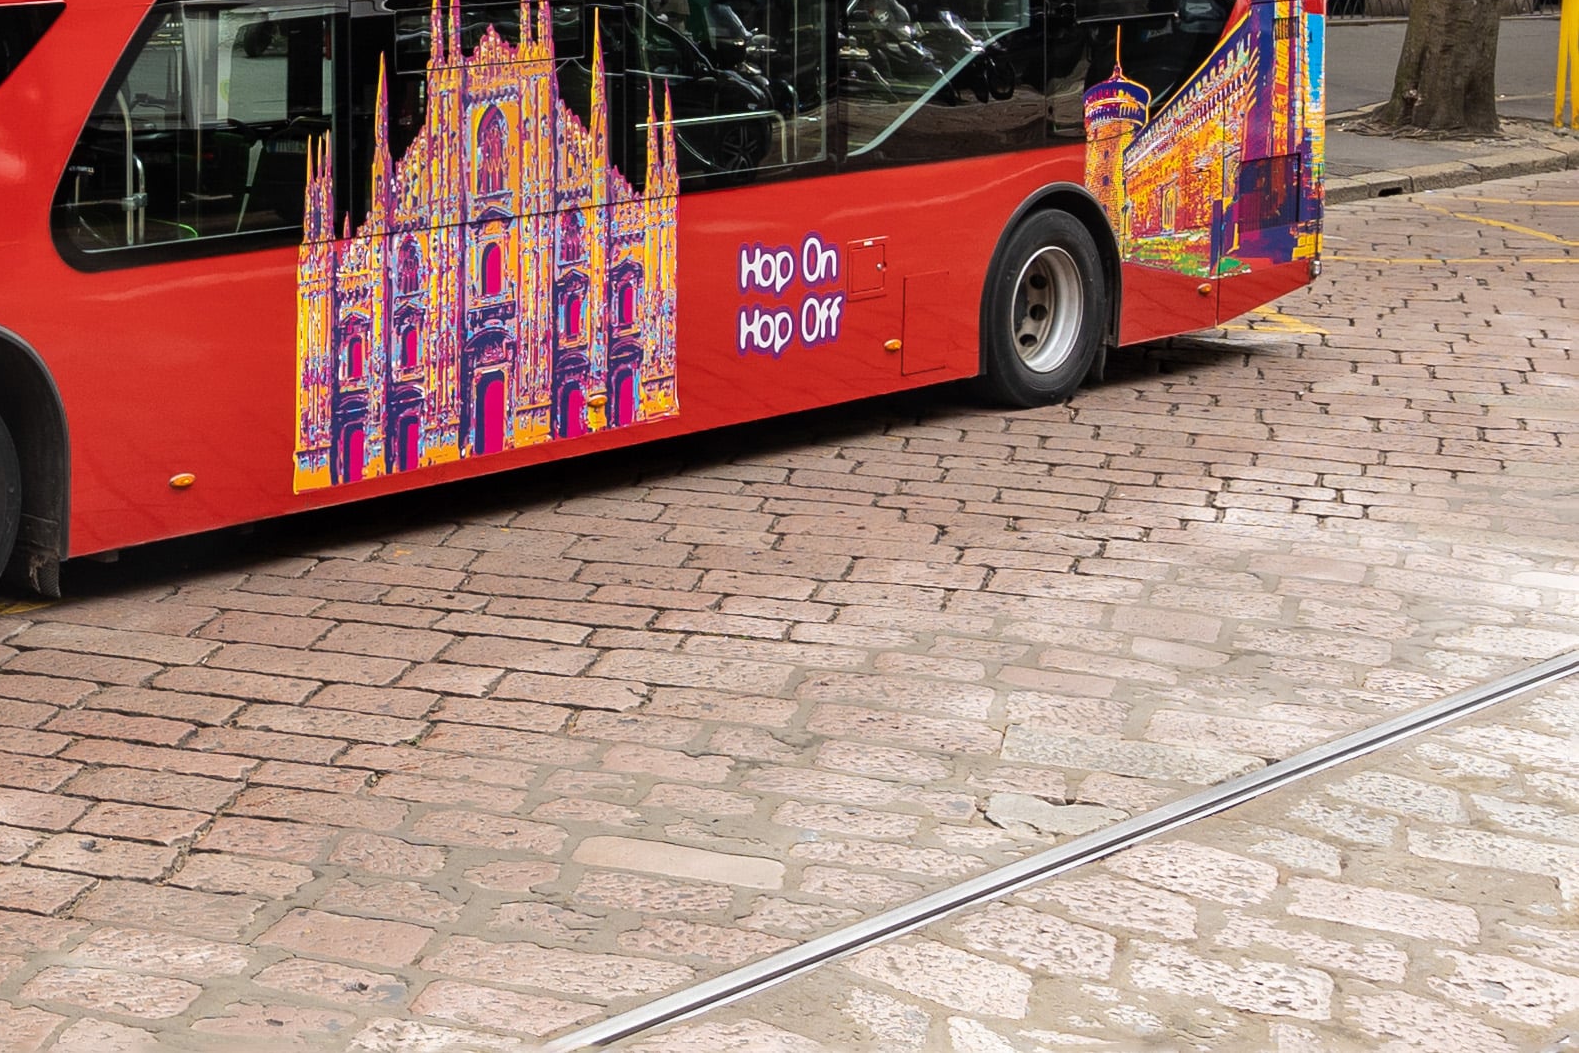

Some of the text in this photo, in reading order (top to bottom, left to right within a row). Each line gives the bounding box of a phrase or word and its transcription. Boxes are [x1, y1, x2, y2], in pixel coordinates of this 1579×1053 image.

[741, 237, 837, 293] Hop On
[740, 296, 843, 353] Hop Off
